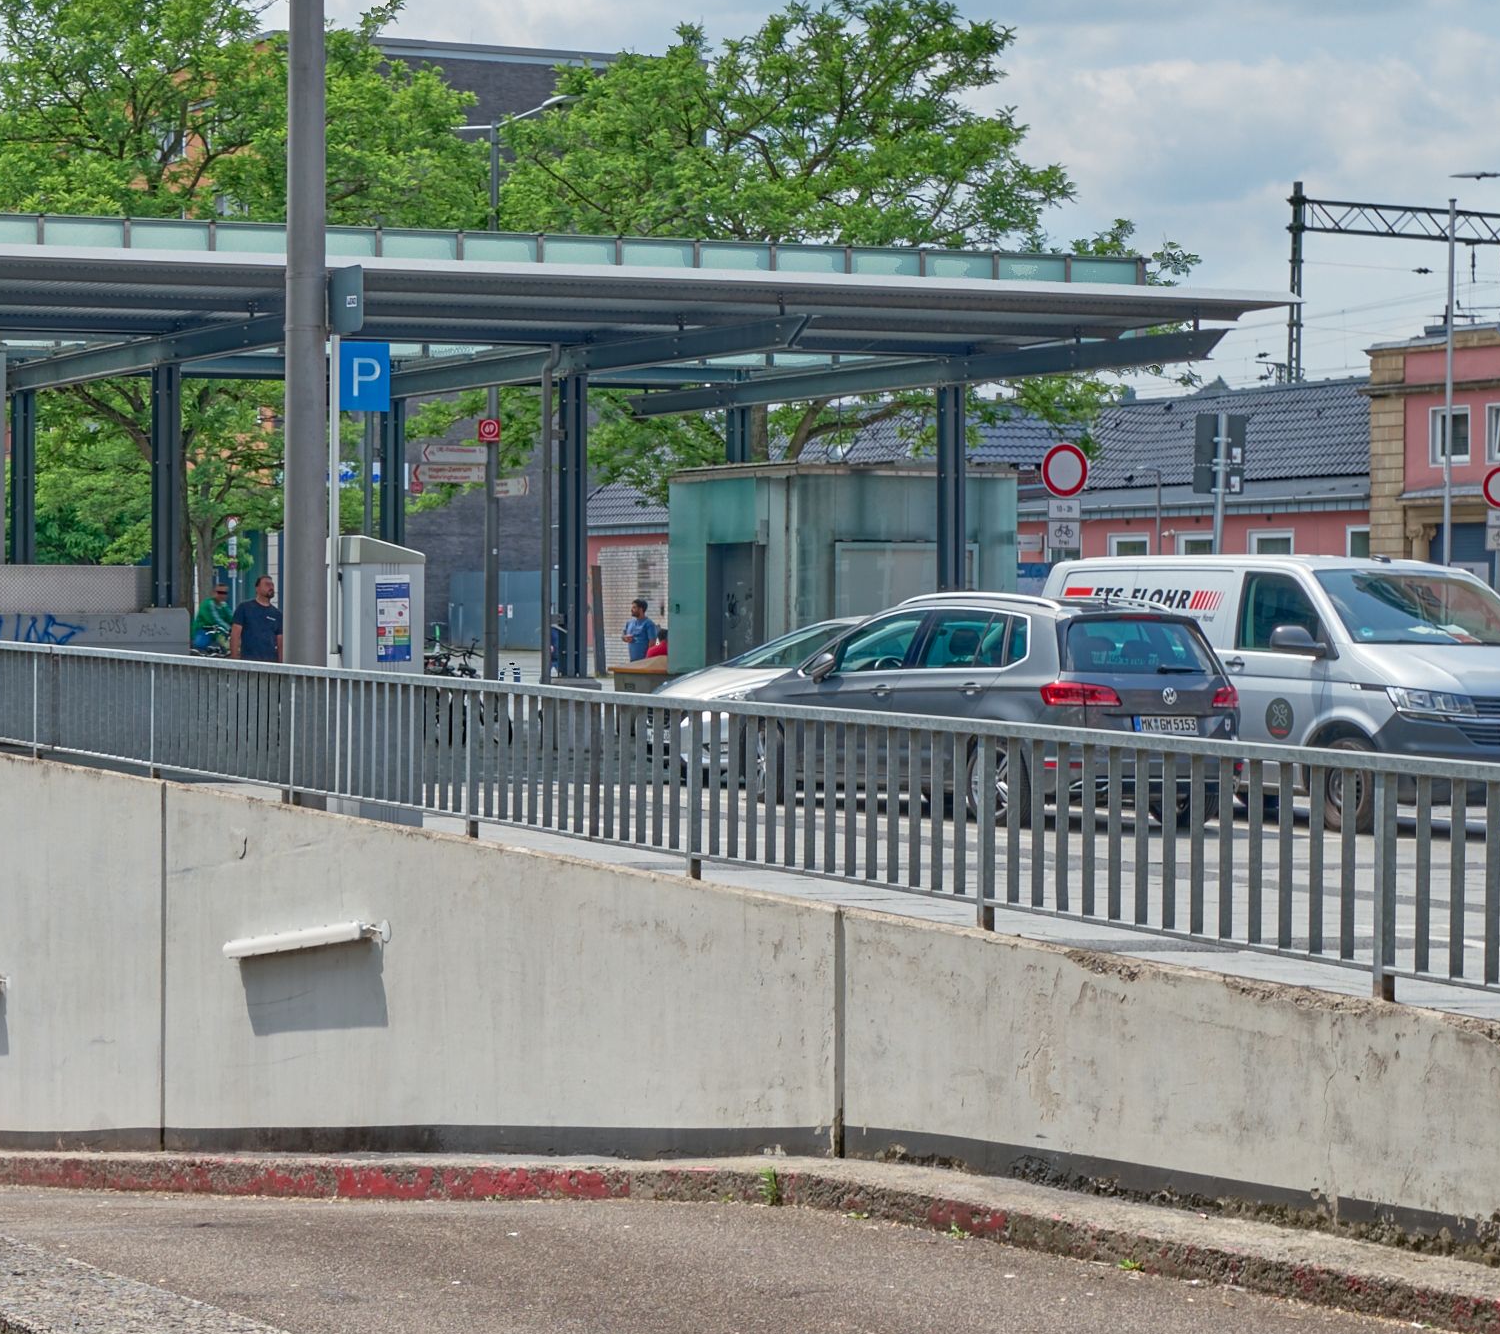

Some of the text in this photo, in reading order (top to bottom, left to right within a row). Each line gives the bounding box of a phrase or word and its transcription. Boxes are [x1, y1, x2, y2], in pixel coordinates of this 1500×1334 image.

[353, 357, 381, 397] P
[1141, 717, 1197, 731] MK GM 5153
